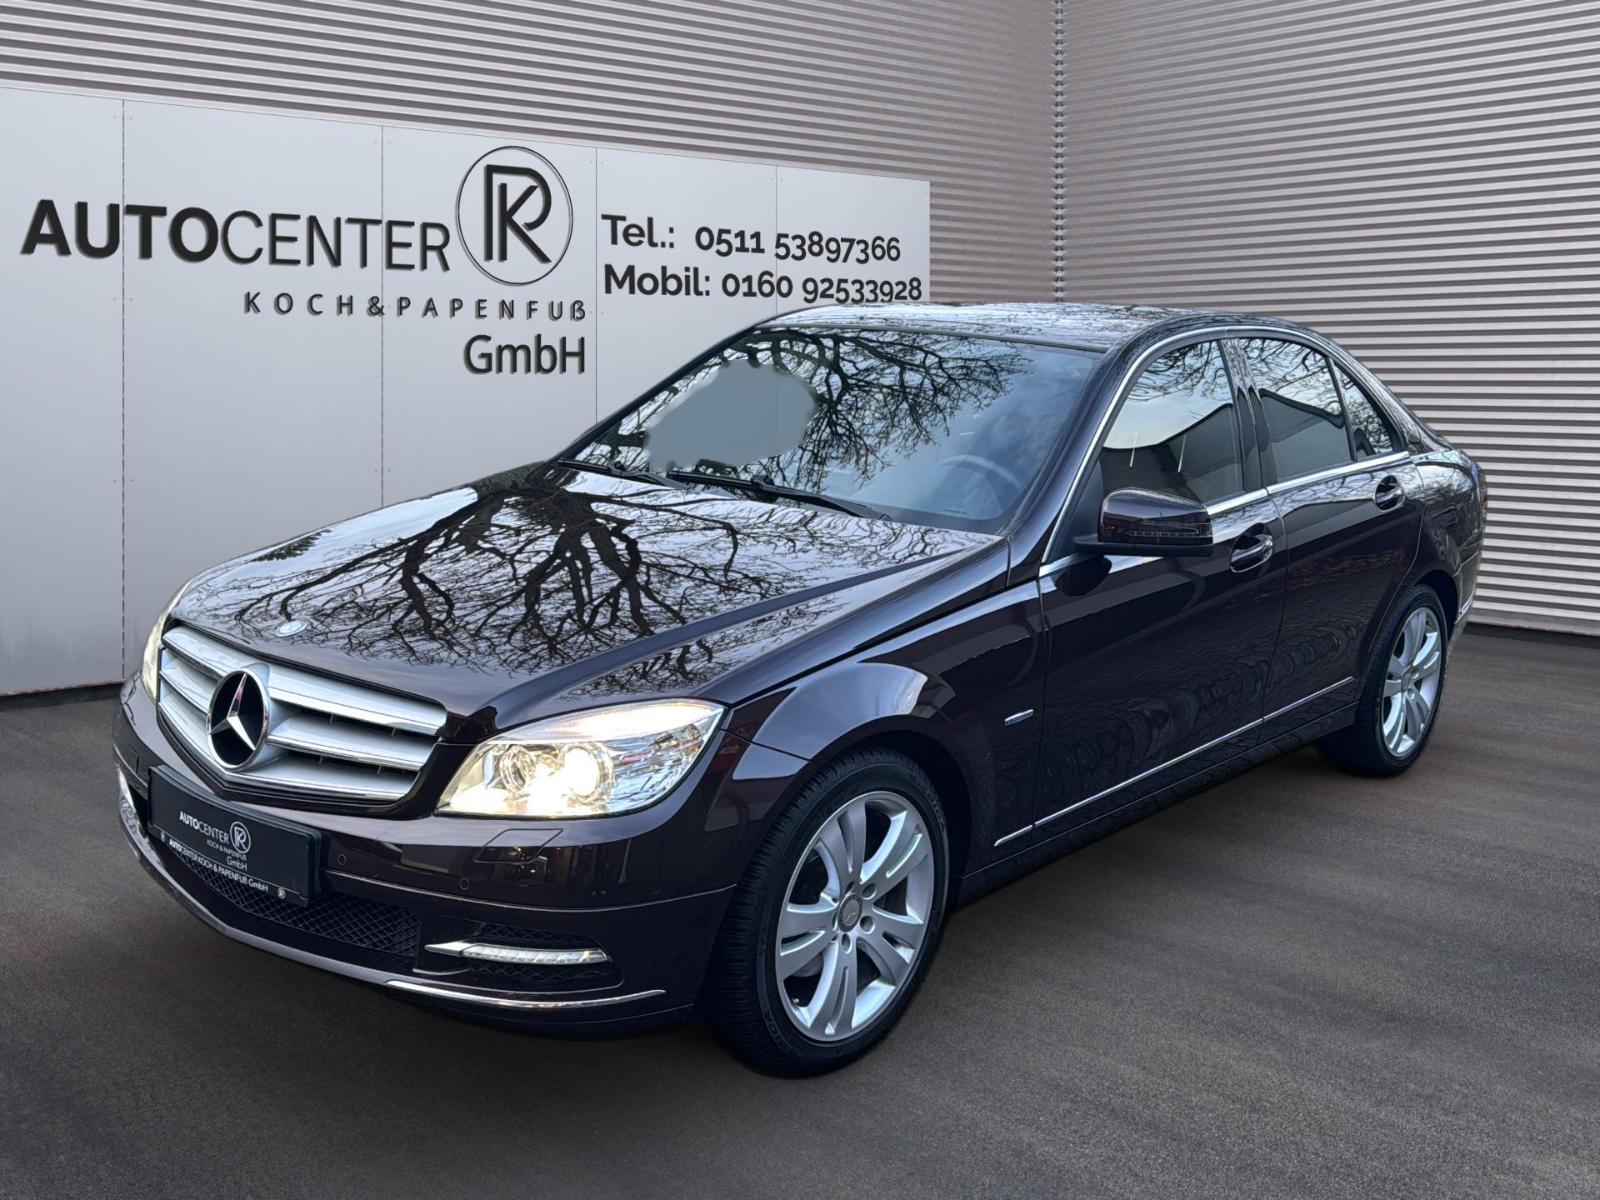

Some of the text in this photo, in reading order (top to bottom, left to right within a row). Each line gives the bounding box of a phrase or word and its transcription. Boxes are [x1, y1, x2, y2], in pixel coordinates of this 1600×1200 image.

[20, 198, 451, 273] AUTOCENTER
[601, 213, 902, 265] Tel.: 0511 53897366
[603, 263, 923, 305] Mobil: 0160 92533928
[463, 333, 586, 376] GmbH
[179, 811, 230, 845] AUTOCENTER
